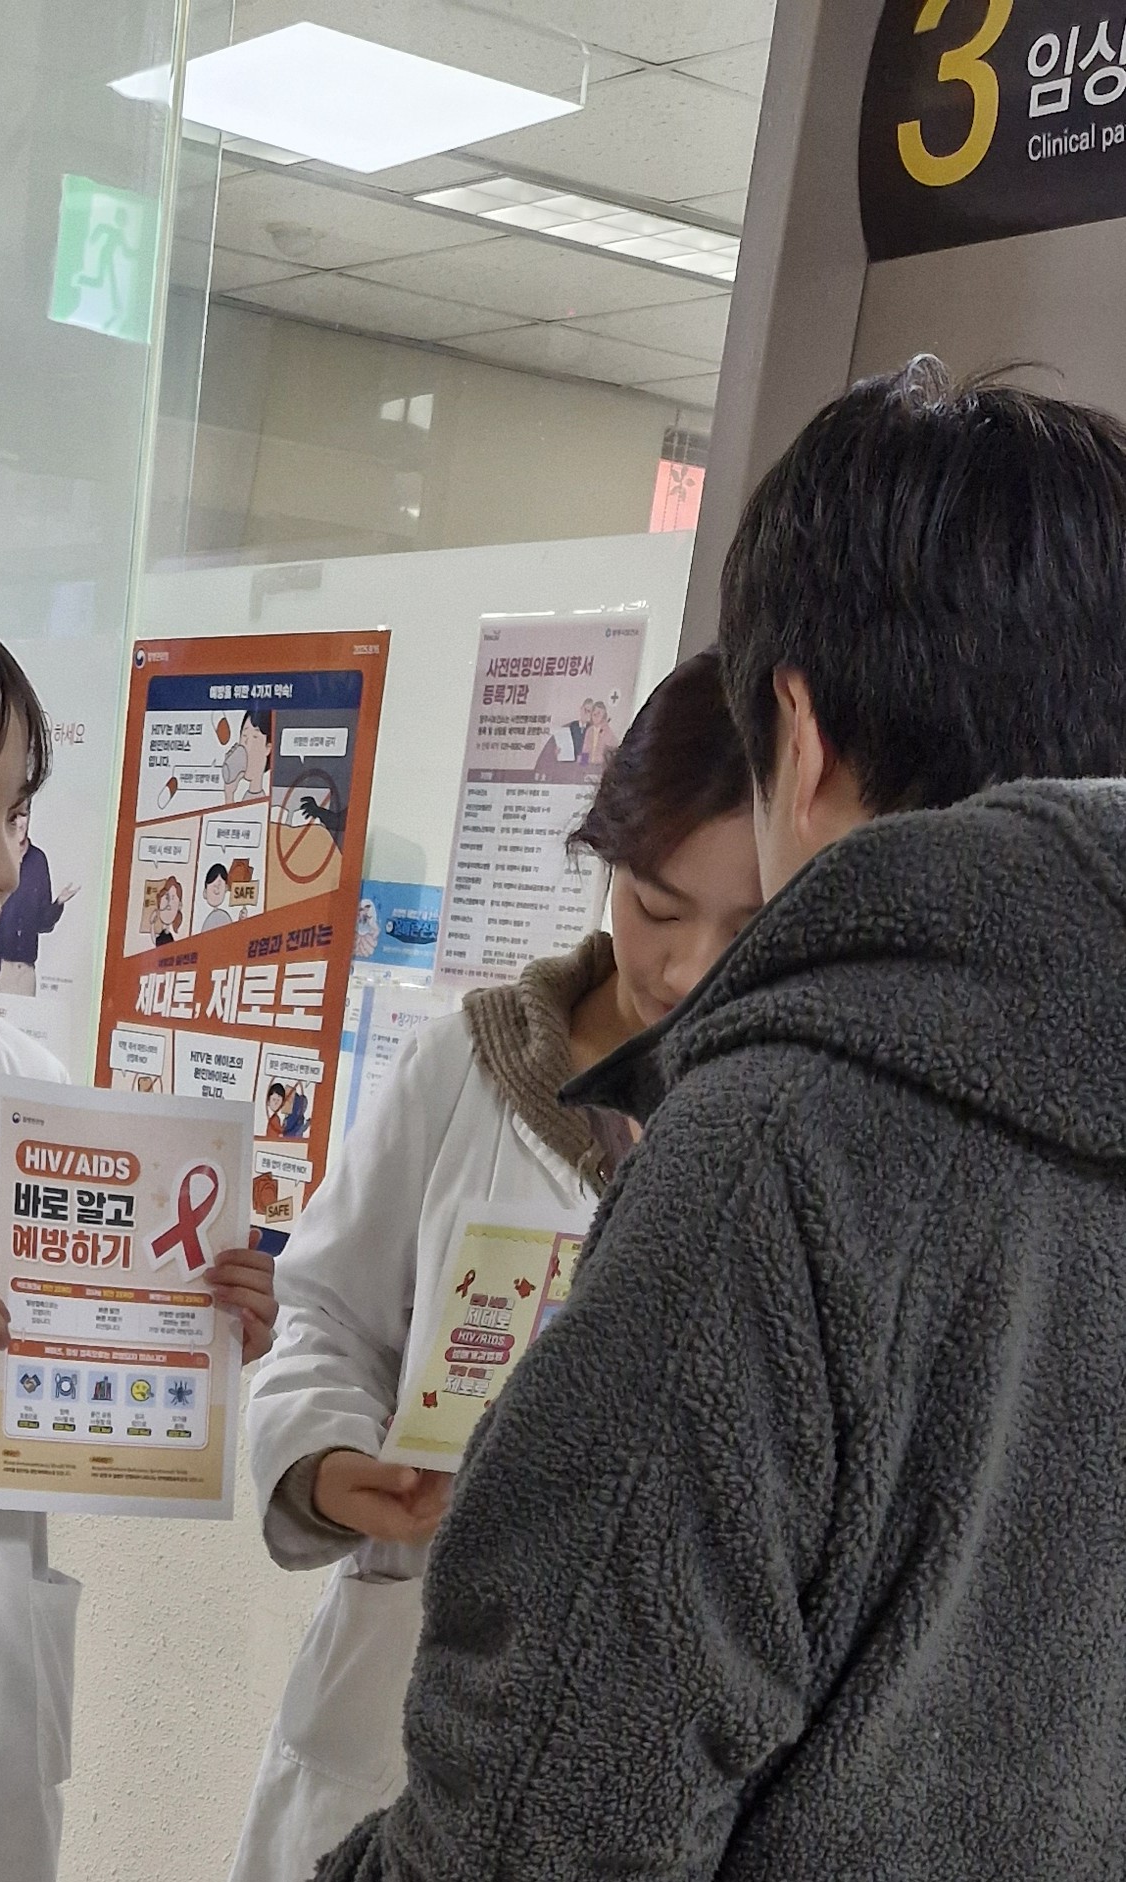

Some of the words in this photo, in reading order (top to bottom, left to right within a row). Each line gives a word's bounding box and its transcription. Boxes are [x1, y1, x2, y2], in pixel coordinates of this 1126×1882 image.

[1027, 19, 1126, 118] 임상
[897, 0, 1014, 187] 3
[1028, 122, 1096, 161] Clinical
[1101, 122, 1126, 152] pa
[486, 655, 594, 678] 사전연명의료의향서
[234, 685, 250, 699] 위한
[251, 684, 272, 698] 4가지
[274, 684, 293, 698] 약속!
[482, 684, 530, 705] 등록기관
[54, 722, 85, 746] 하세요
[151, 724, 173, 736] HIV는
[174, 723, 203, 736] 에이즈의
[150, 739, 191, 752] 원인바이러스
[148, 755, 171, 768] 입니다.
[234, 886, 255, 899] SAFE
[247, 934, 283, 959] 감염과
[285, 924, 333, 952] 전파는
[135, 970, 202, 1020] 제대로,
[205, 959, 329, 1032] 제로로
[190, 1050, 212, 1066] HIV는
[214, 1053, 244, 1069] 에이즈의
[193, 1067, 237, 1085] 원인바이러스
[202, 1084, 225, 1100] 입니다.
[25, 1145, 130, 1180] HIV/AIDS
[14, 1182, 69, 1222] 바로
[76, 1190, 135, 1228] 알고
[267, 1204, 290, 1218] SAFE
[12, 1224, 131, 1270] 예방하기
[463, 1306, 513, 1330] 제대로
[457, 1329, 505, 1346] HIV/AIDS
